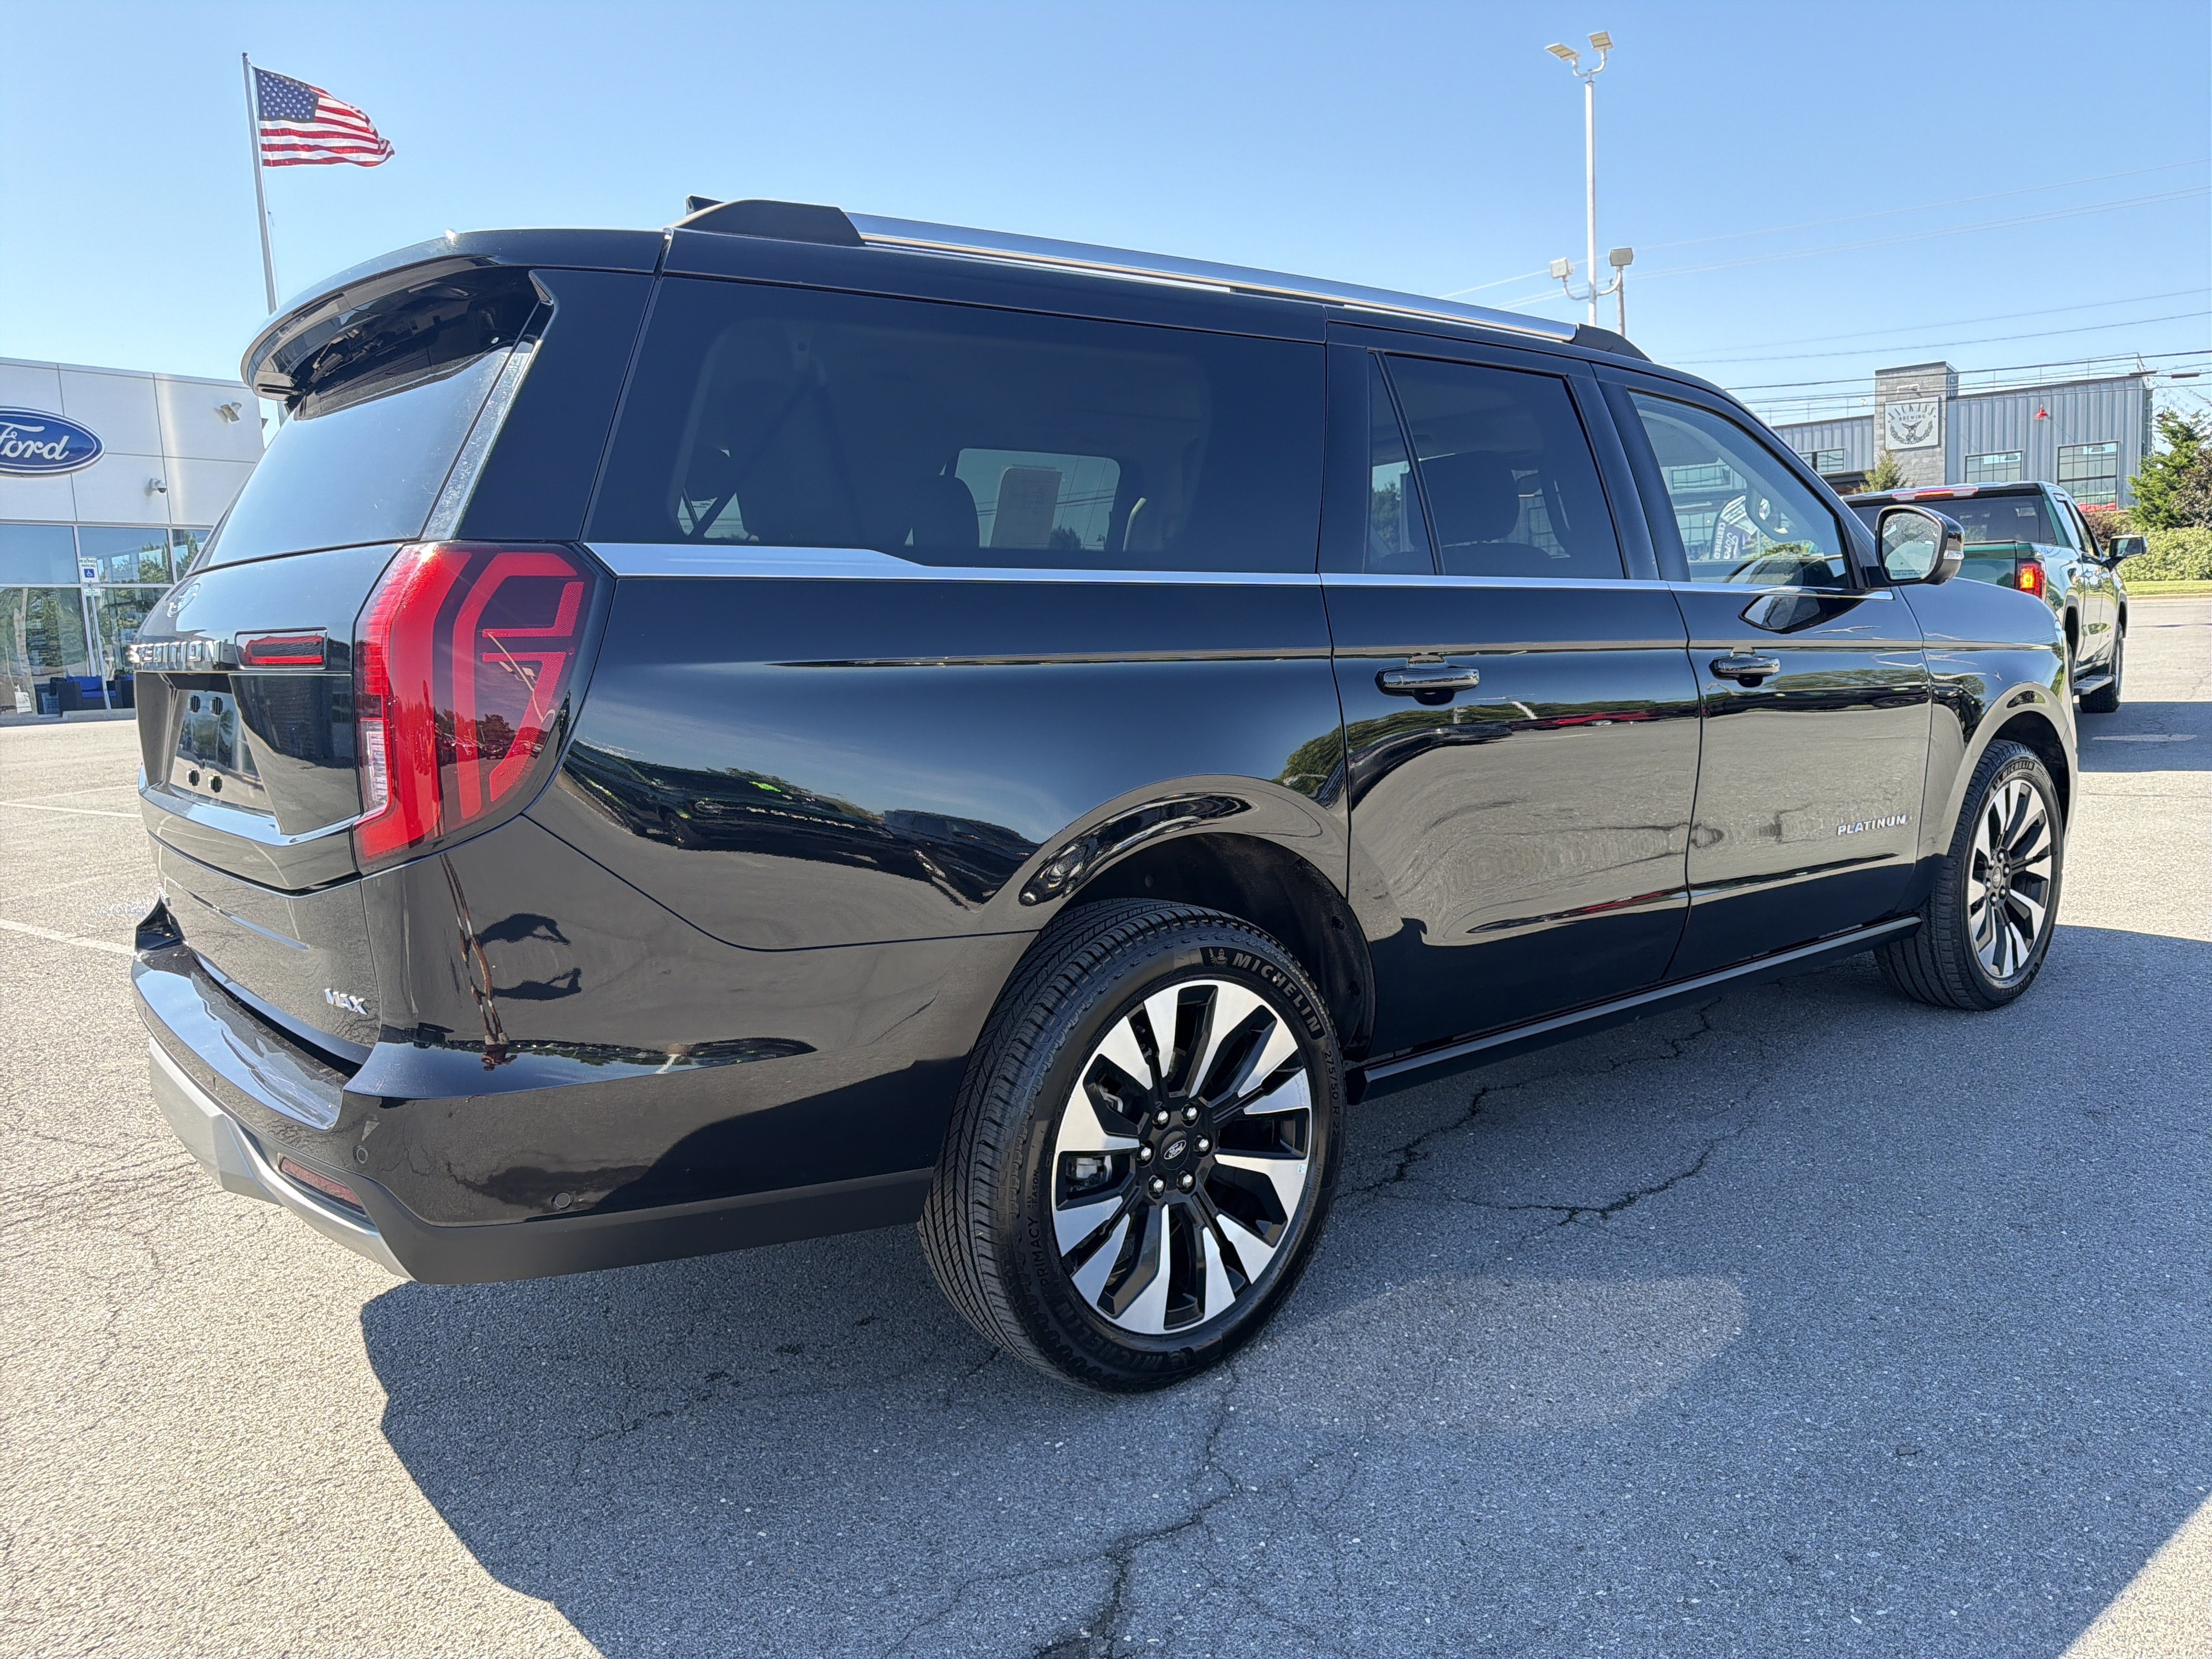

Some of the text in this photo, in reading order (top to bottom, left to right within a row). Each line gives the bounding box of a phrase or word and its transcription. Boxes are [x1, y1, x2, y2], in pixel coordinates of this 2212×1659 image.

[2002, 760, 2034, 778] MICHELIN
[1837, 814, 1906, 836] PLATINUM
[1232, 952, 1321, 1032] MICHELIN
[1324, 1050, 1339, 1100] 275/50
[1031, 1169, 1040, 1210] SEASON
[1028, 1216, 1050, 1287] PRIMACY
